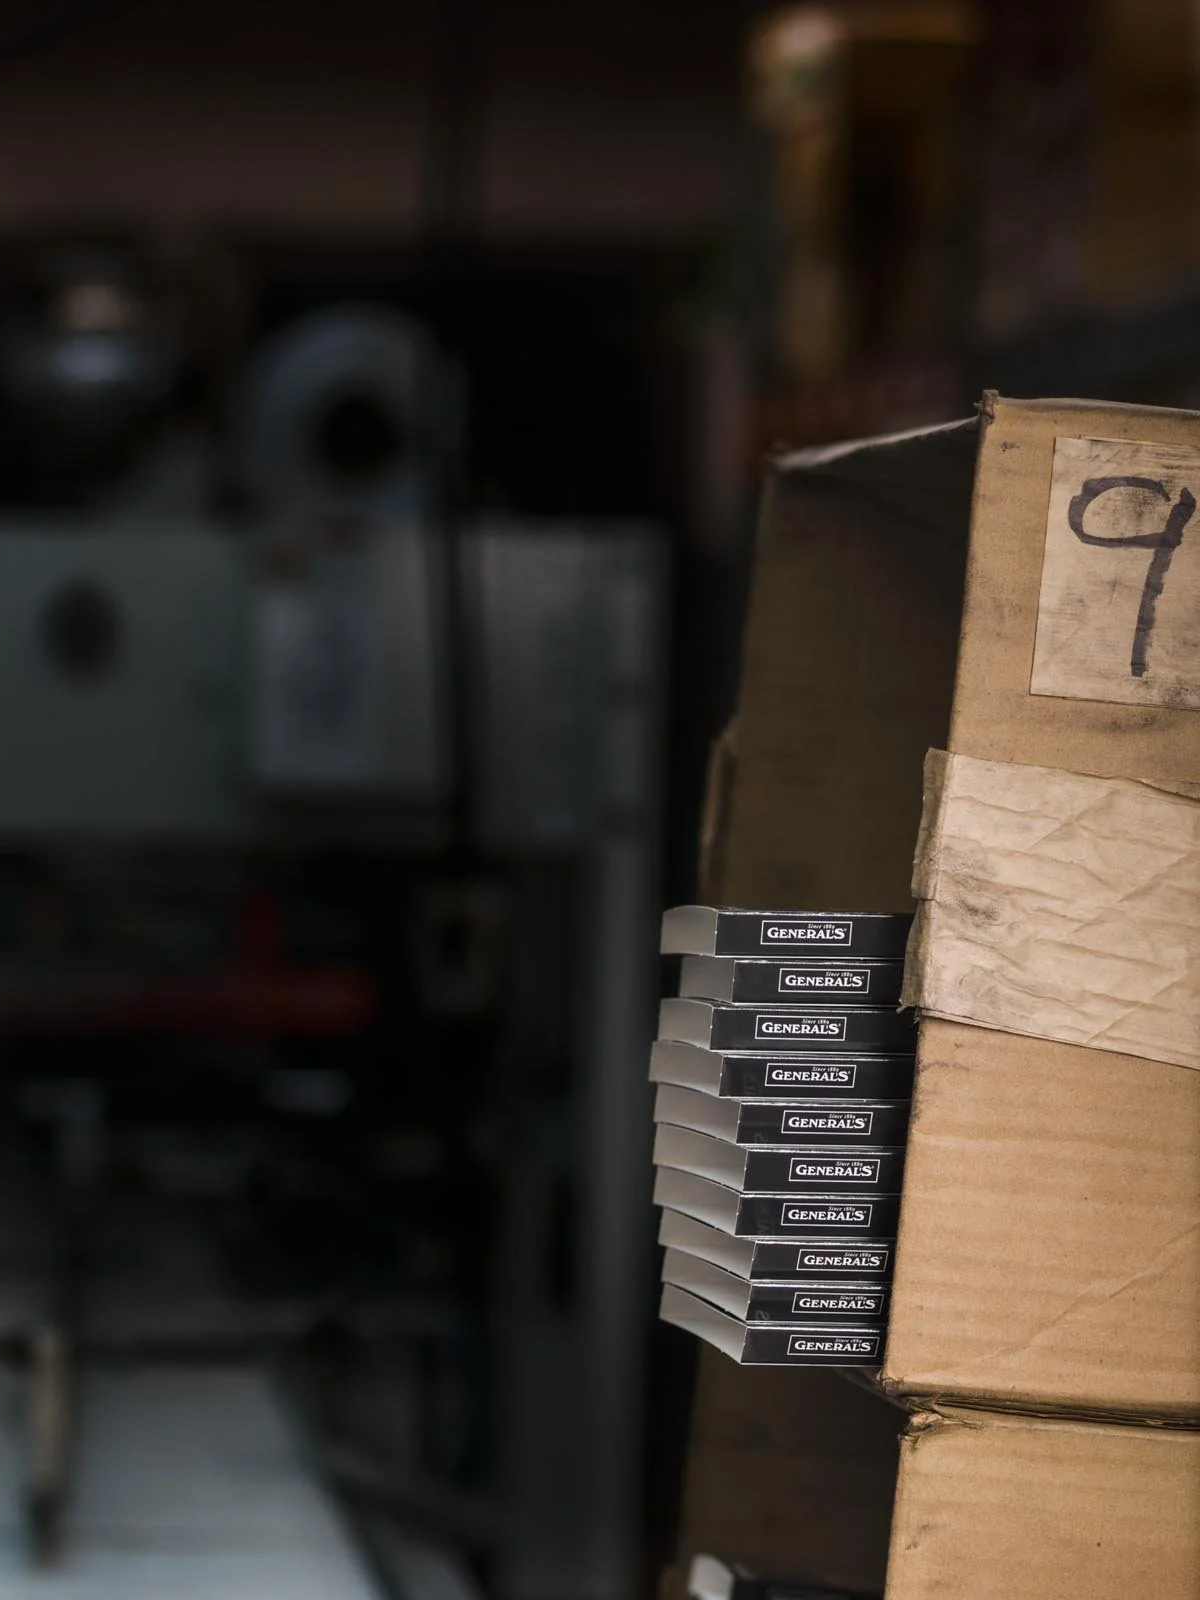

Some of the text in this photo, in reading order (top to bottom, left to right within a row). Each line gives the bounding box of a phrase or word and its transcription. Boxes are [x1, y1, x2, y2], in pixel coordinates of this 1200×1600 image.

[1067, 475, 1197, 677] 9
[767, 927, 845, 940] GENERAL'S
[785, 975, 863, 987] GENERAL'S
[761, 1021, 839, 1035] GENERAL'S
[771, 1069, 849, 1082] GENERAL'S
[788, 1116, 865, 1129] GENERAL'S
[795, 1164, 873, 1177] GENERAL'S
[788, 1209, 865, 1221] GENERAL'S
[804, 1255, 880, 1267] GENERAL'S
